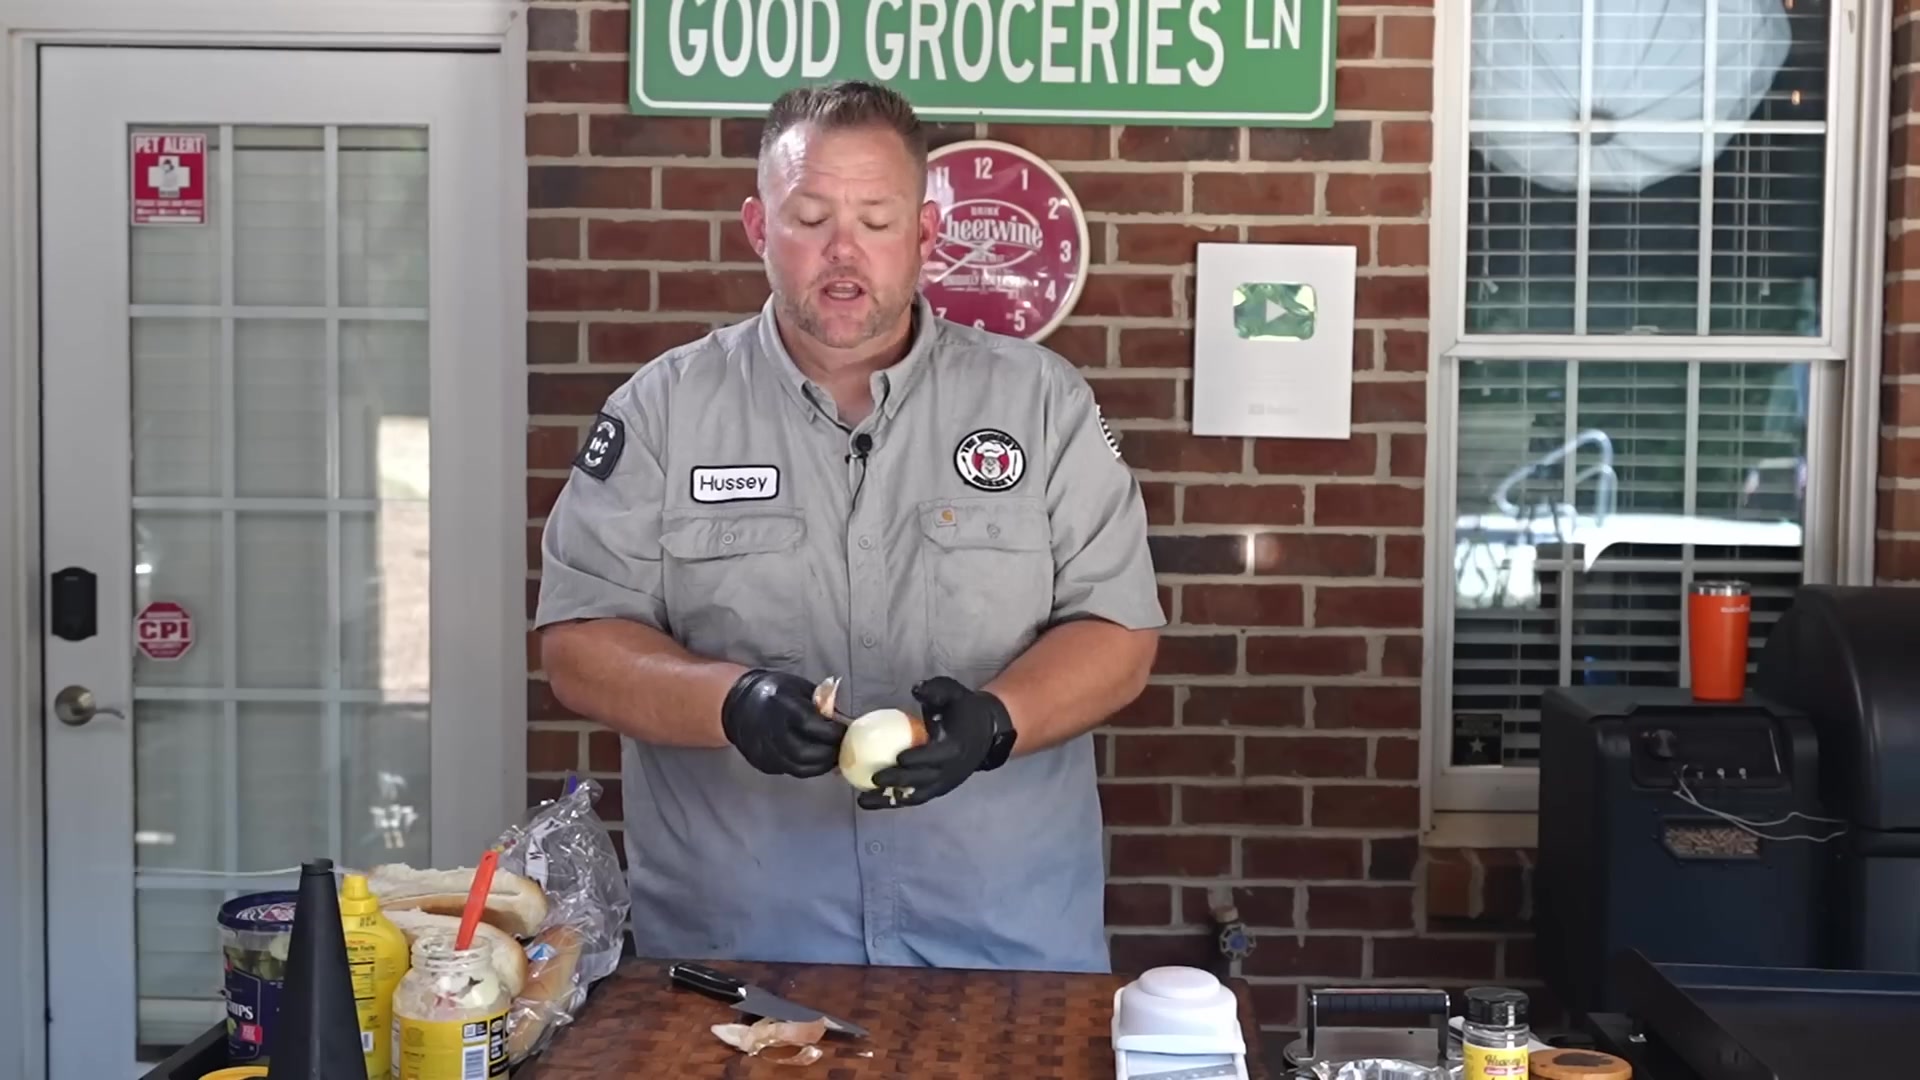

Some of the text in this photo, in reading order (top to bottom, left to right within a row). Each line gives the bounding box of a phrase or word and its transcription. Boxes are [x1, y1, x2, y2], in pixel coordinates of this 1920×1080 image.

[669, 0, 1300, 87] GOOD GROCERIES LN
[135, 136, 203, 153] PET ALERT
[936, 166, 949, 188] 11
[974, 157, 993, 179] 12
[1021, 168, 1029, 190] 1
[1048, 197, 1060, 219] 2
[944, 215, 1043, 248] heerwine
[1060, 240, 1071, 262] 3
[1045, 279, 1056, 301] 4
[1014, 309, 1025, 331] 5
[699, 475, 768, 492] Hussey
[139, 621, 189, 640] CPI
